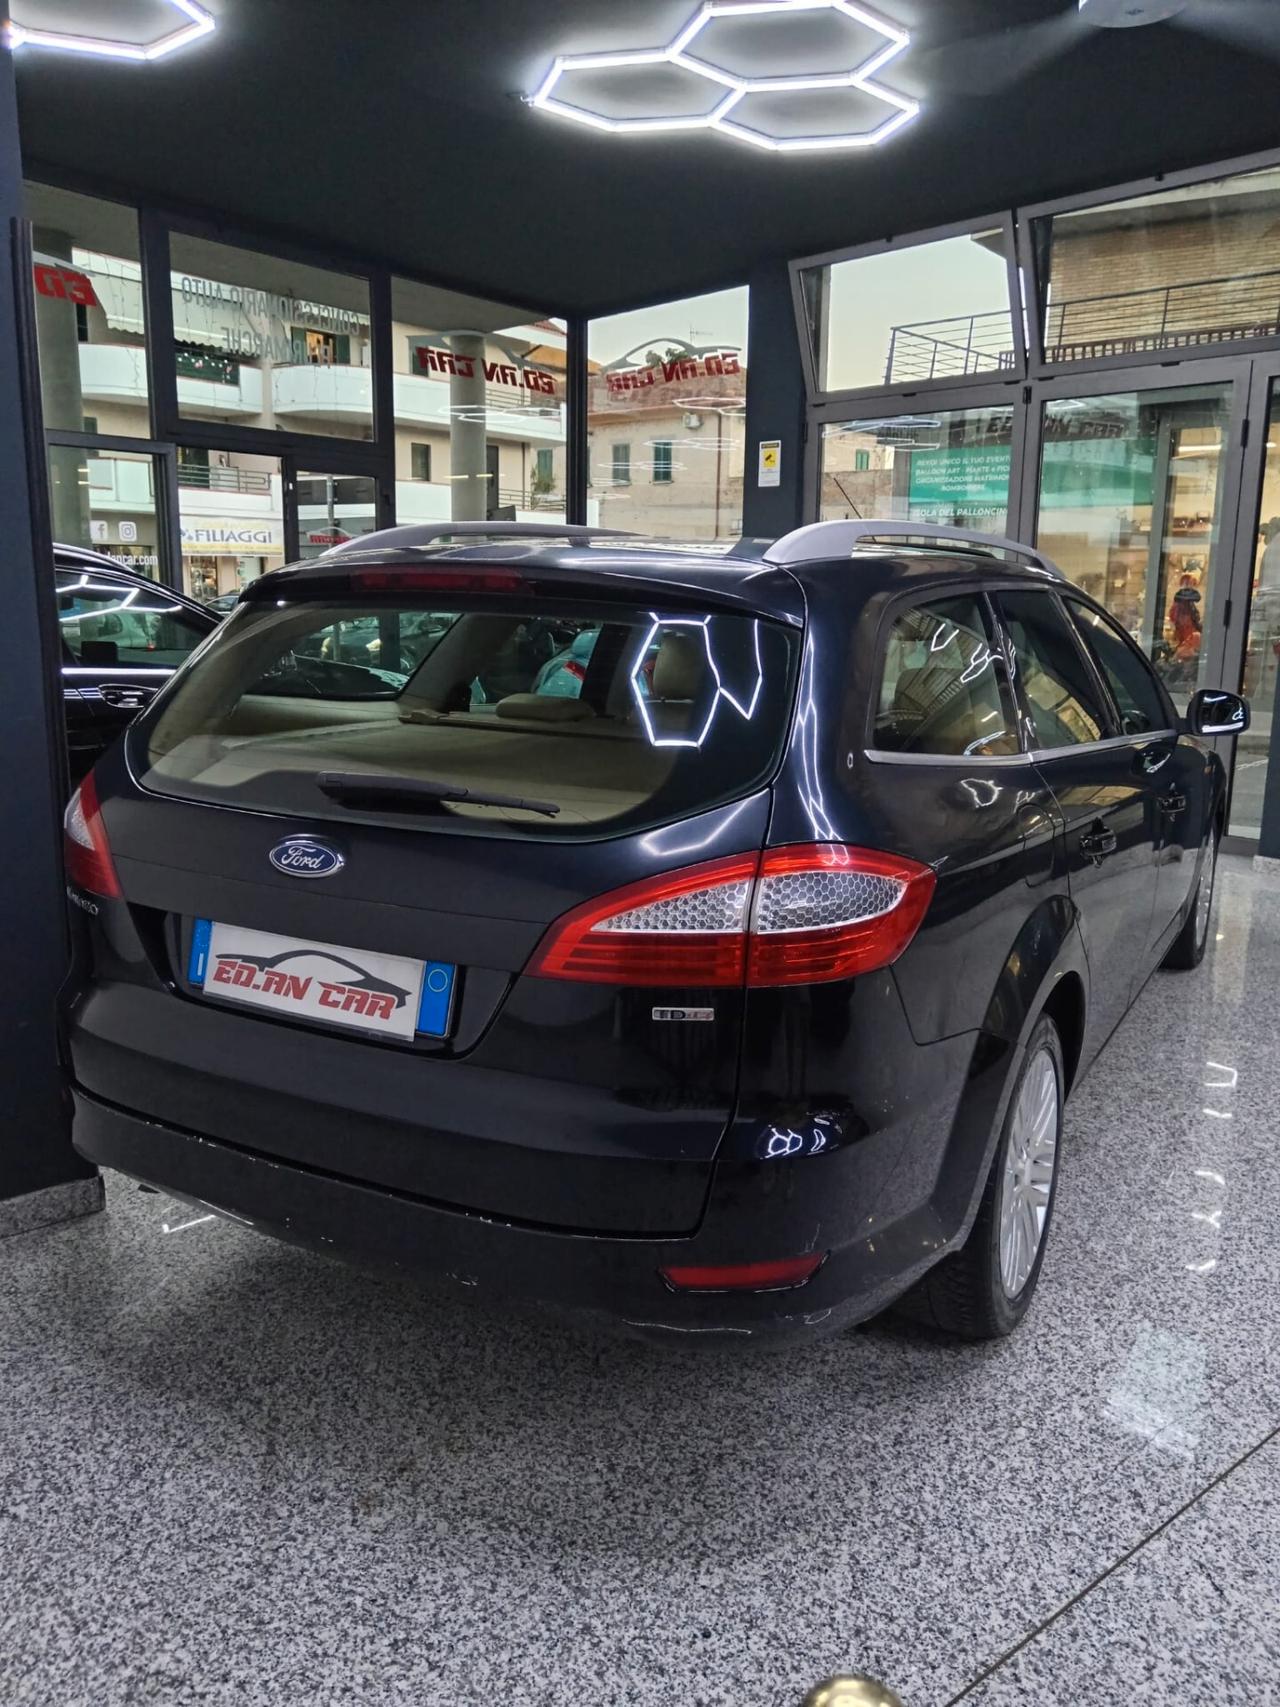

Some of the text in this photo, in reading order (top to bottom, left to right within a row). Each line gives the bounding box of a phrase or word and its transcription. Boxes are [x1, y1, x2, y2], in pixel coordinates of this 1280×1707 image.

[939, 508, 955, 517] DEL
[193, 529, 273, 544] FILIAGGI
[280, 845, 325, 870] Ford
[213, 959, 396, 1020] ED.AN CAR
